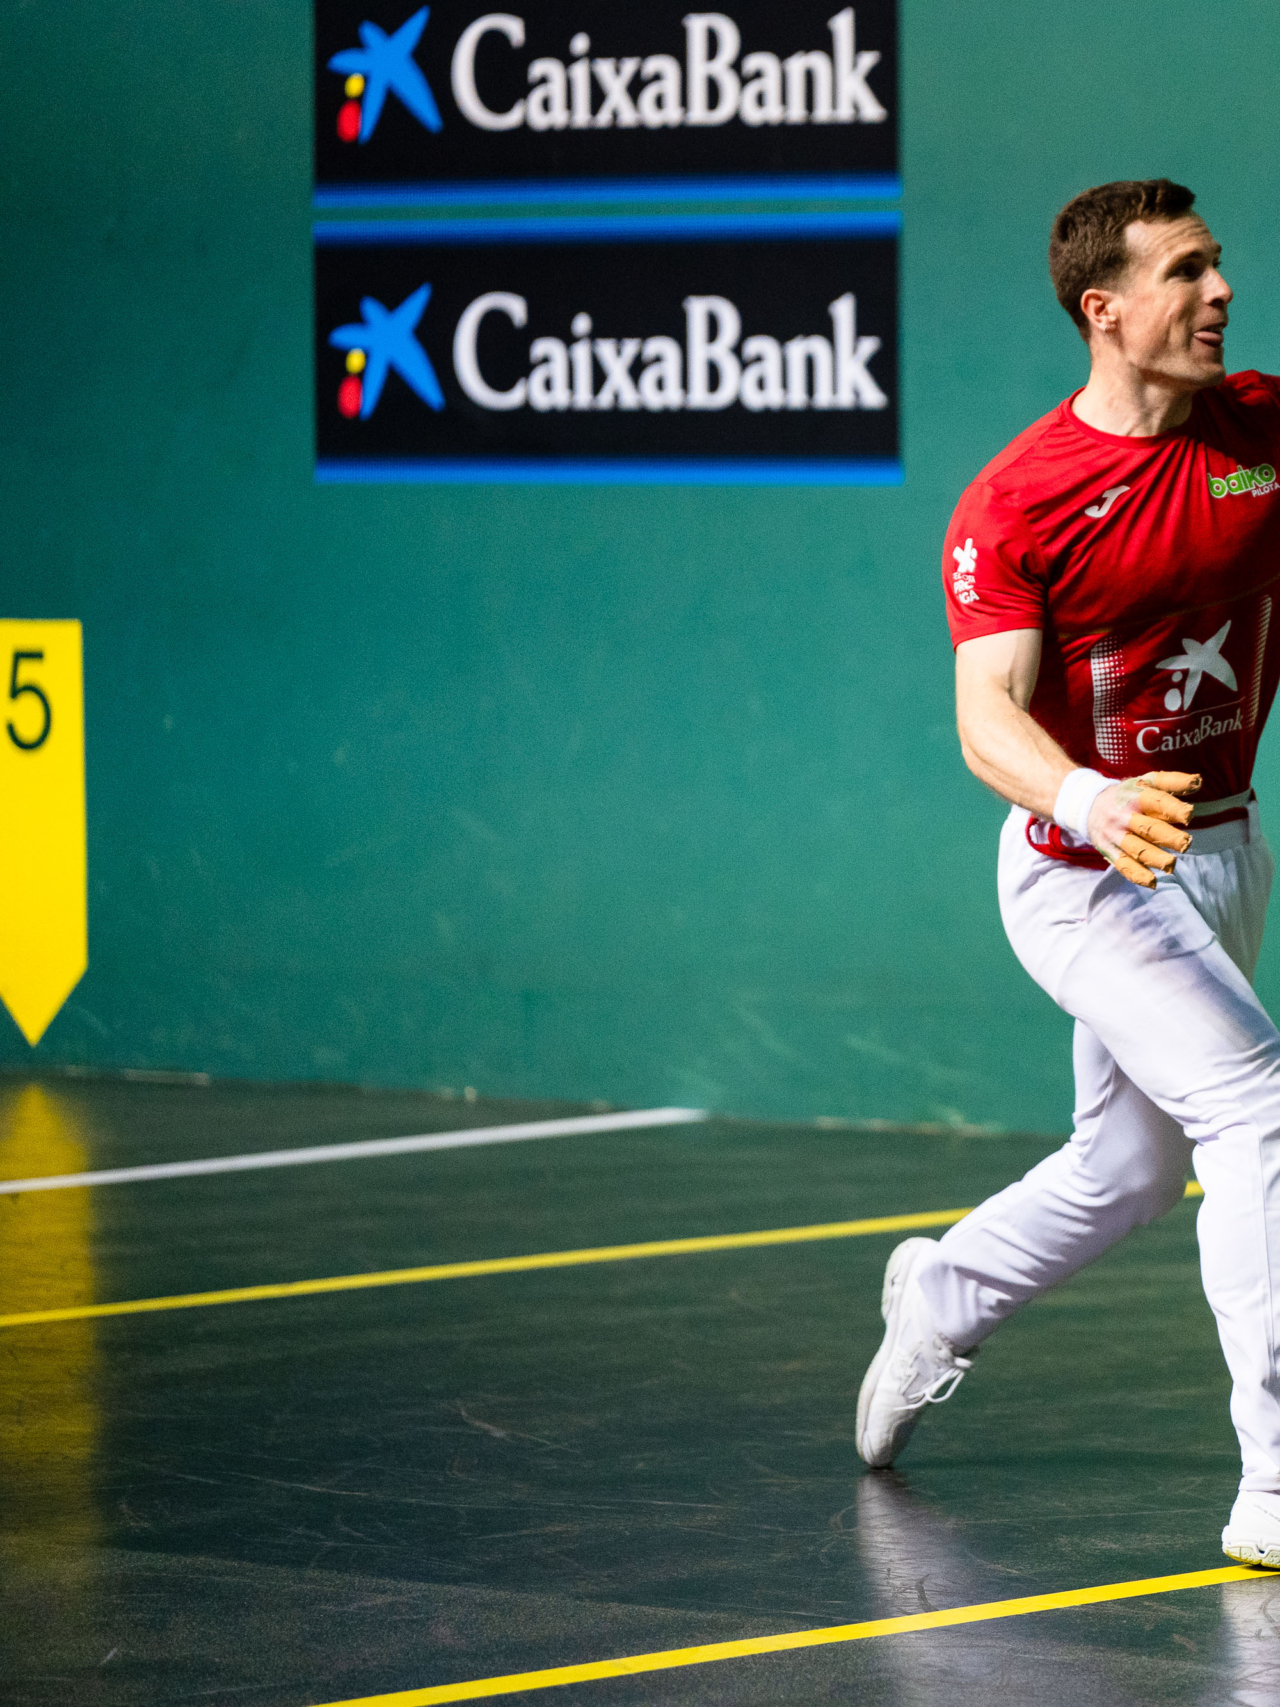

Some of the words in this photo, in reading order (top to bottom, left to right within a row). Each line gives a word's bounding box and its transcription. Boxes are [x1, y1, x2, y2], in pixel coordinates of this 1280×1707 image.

[450, 7, 887, 130] CaixaBank
[452, 291, 888, 411] CaixaBank
[1251, 482, 1280, 497] PILOTA
[6, 649, 52, 752] 5
[1136, 708, 1243, 754] CaixaBank
